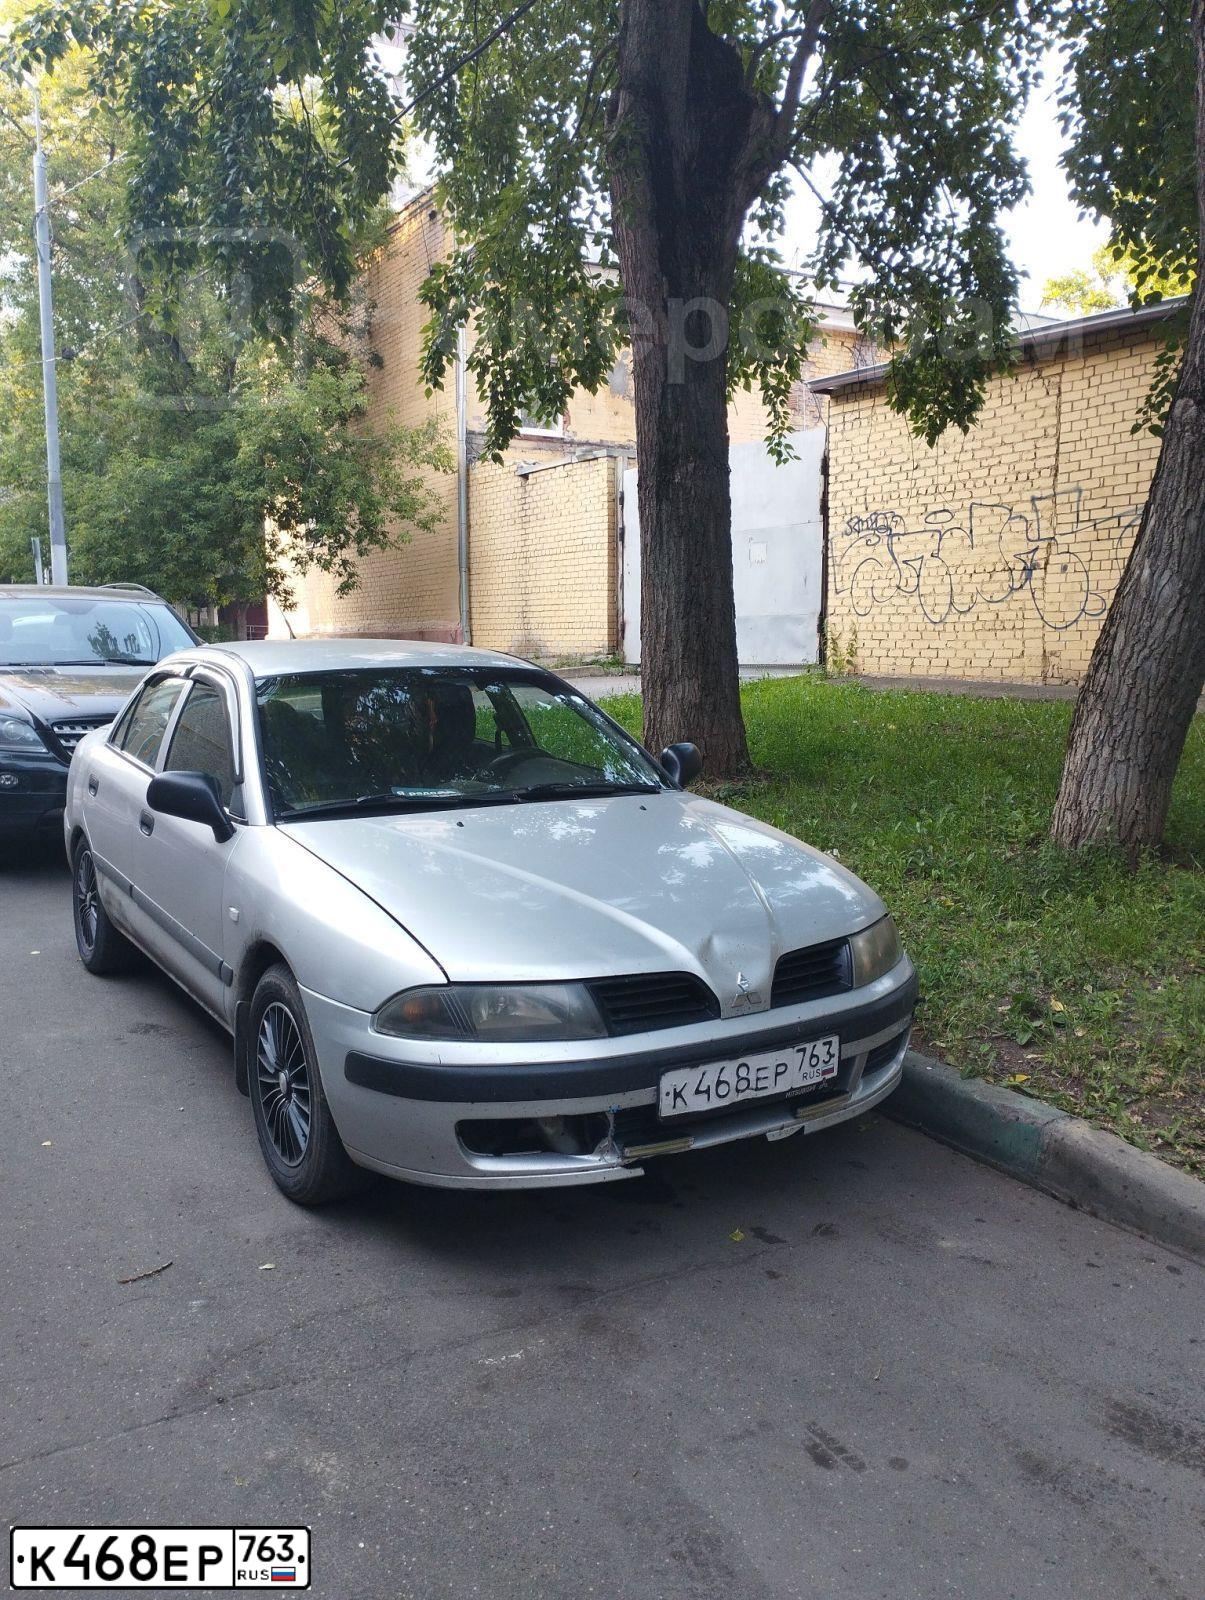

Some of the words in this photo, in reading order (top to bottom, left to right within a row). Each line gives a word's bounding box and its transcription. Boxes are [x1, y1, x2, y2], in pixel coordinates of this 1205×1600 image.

[672, 1063, 788, 1109] К468ЕР
[796, 1040, 835, 1071] 763
[802, 1069, 821, 1081] RUS
